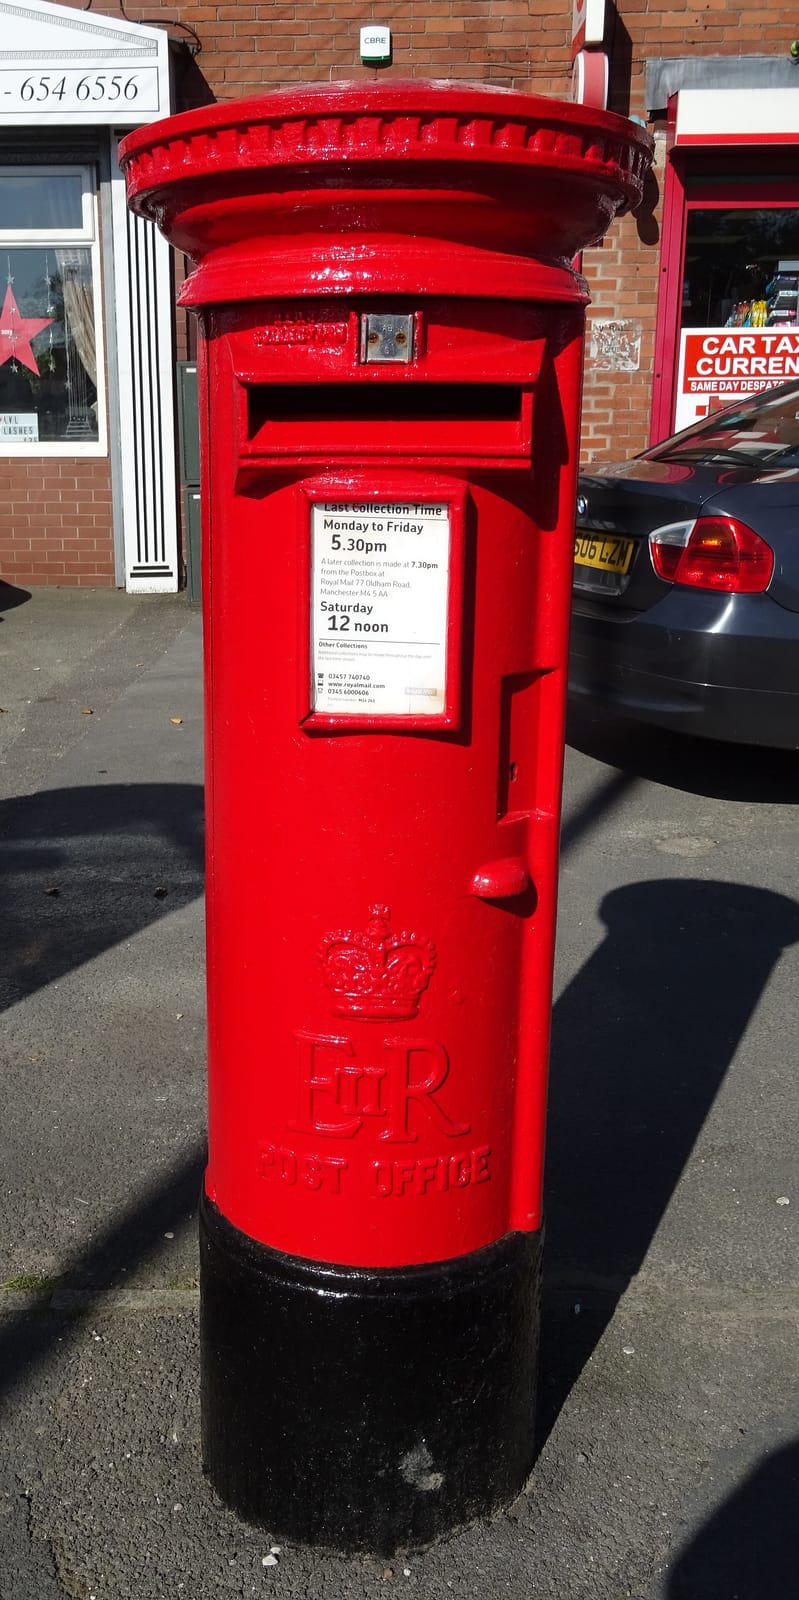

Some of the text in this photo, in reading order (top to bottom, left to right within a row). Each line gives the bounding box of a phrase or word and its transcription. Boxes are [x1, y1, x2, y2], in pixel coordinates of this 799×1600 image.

[20, 76, 66, 101] 654
[76, 74, 140, 101] 6556
[702, 336, 756, 355] CAR
[690, 381, 718, 391] SAME
[719, 380, 741, 391] DAY
[3, 426, 33, 435] LASHES
[324, 503, 442, 516] Last Collection Time
[323, 519, 424, 535] Monday to Friday
[331, 534, 387, 554] 5.30pm
[343, 559, 375, 567] collection
[383, 560, 402, 568] made
[411, 561, 438, 570] 7.30pm
[338, 568, 350, 576] the
[350, 569, 377, 577] Postbox
[320, 578, 339, 587] Royal
[365, 580, 392, 588] Oldham
[320, 588, 359, 597] Manchester
[360, 589, 371, 597] M4
[378, 590, 388, 598] AA
[320, 601, 373, 615] Saturday
[327, 615, 389, 633] 12 noon
[328, 681, 385, 690] www.royalmail.com
[343, 688, 369, 696] 6000606
[255, 1139, 493, 1198] POST OFFICE
